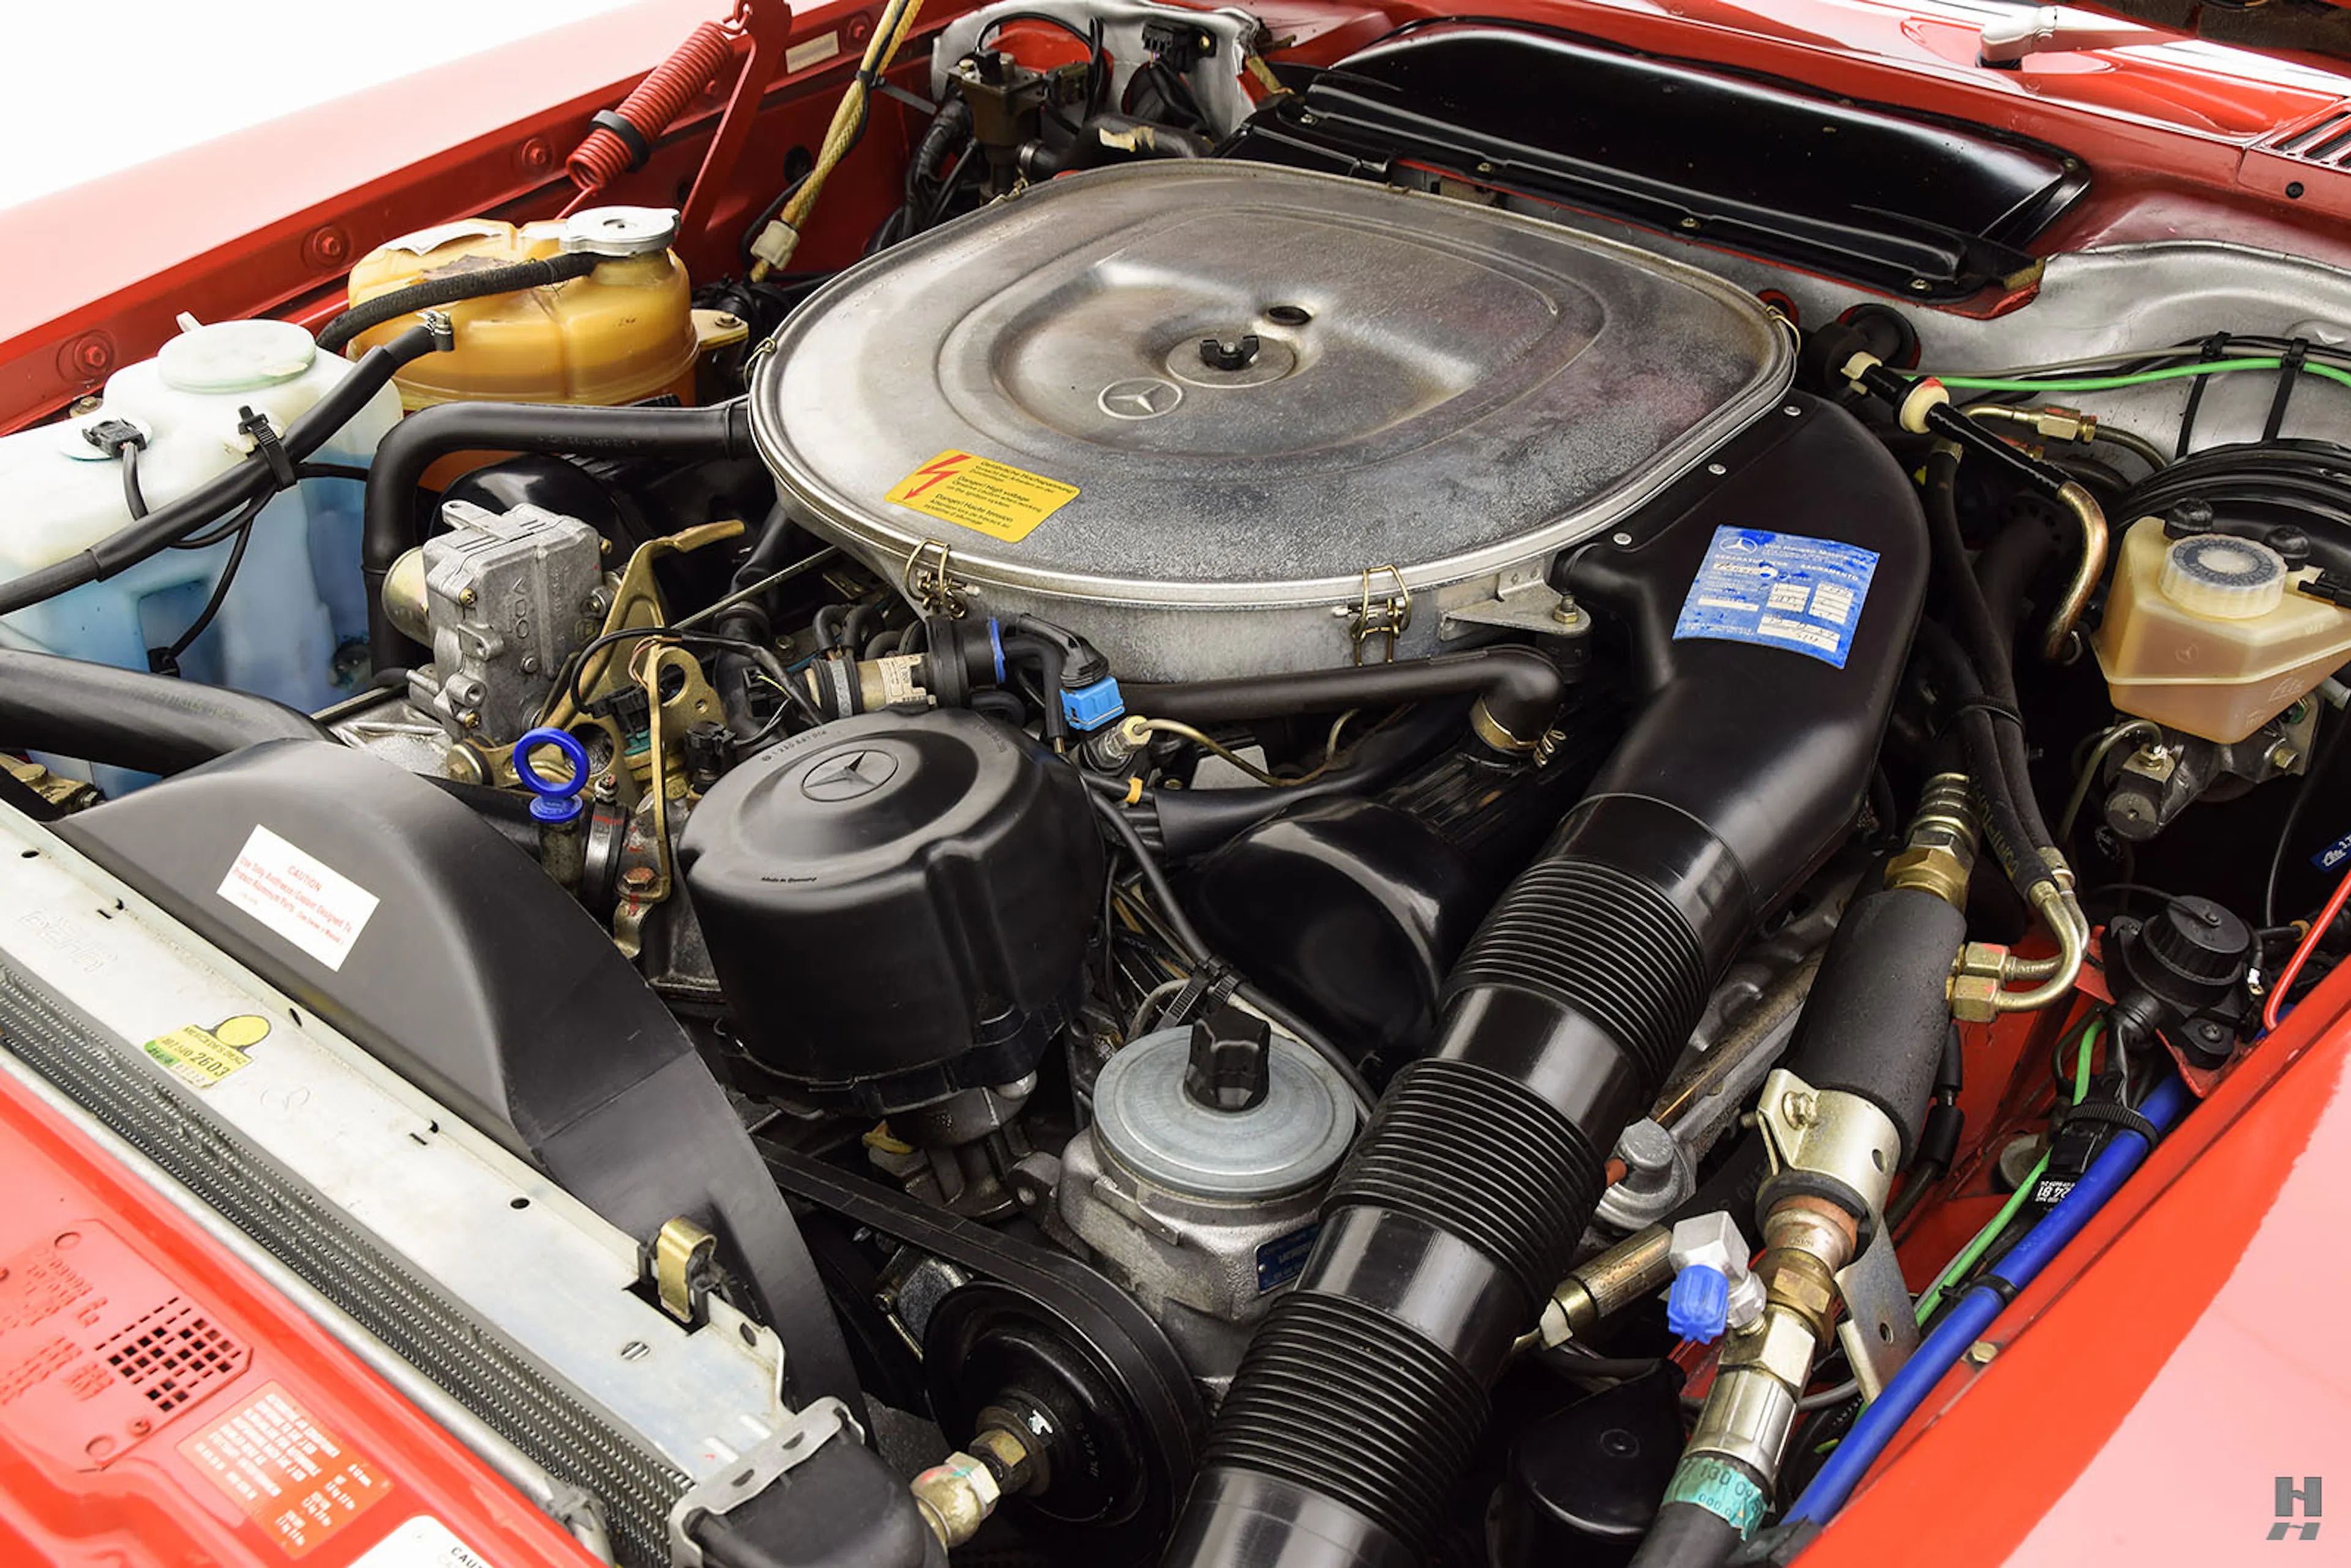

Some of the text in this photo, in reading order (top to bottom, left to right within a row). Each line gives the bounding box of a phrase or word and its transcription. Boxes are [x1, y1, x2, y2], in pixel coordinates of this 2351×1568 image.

[512, 577, 530, 639] VDO
[287, 865, 323, 892] CAUTION
[1700, 1465, 1732, 1486] 130
